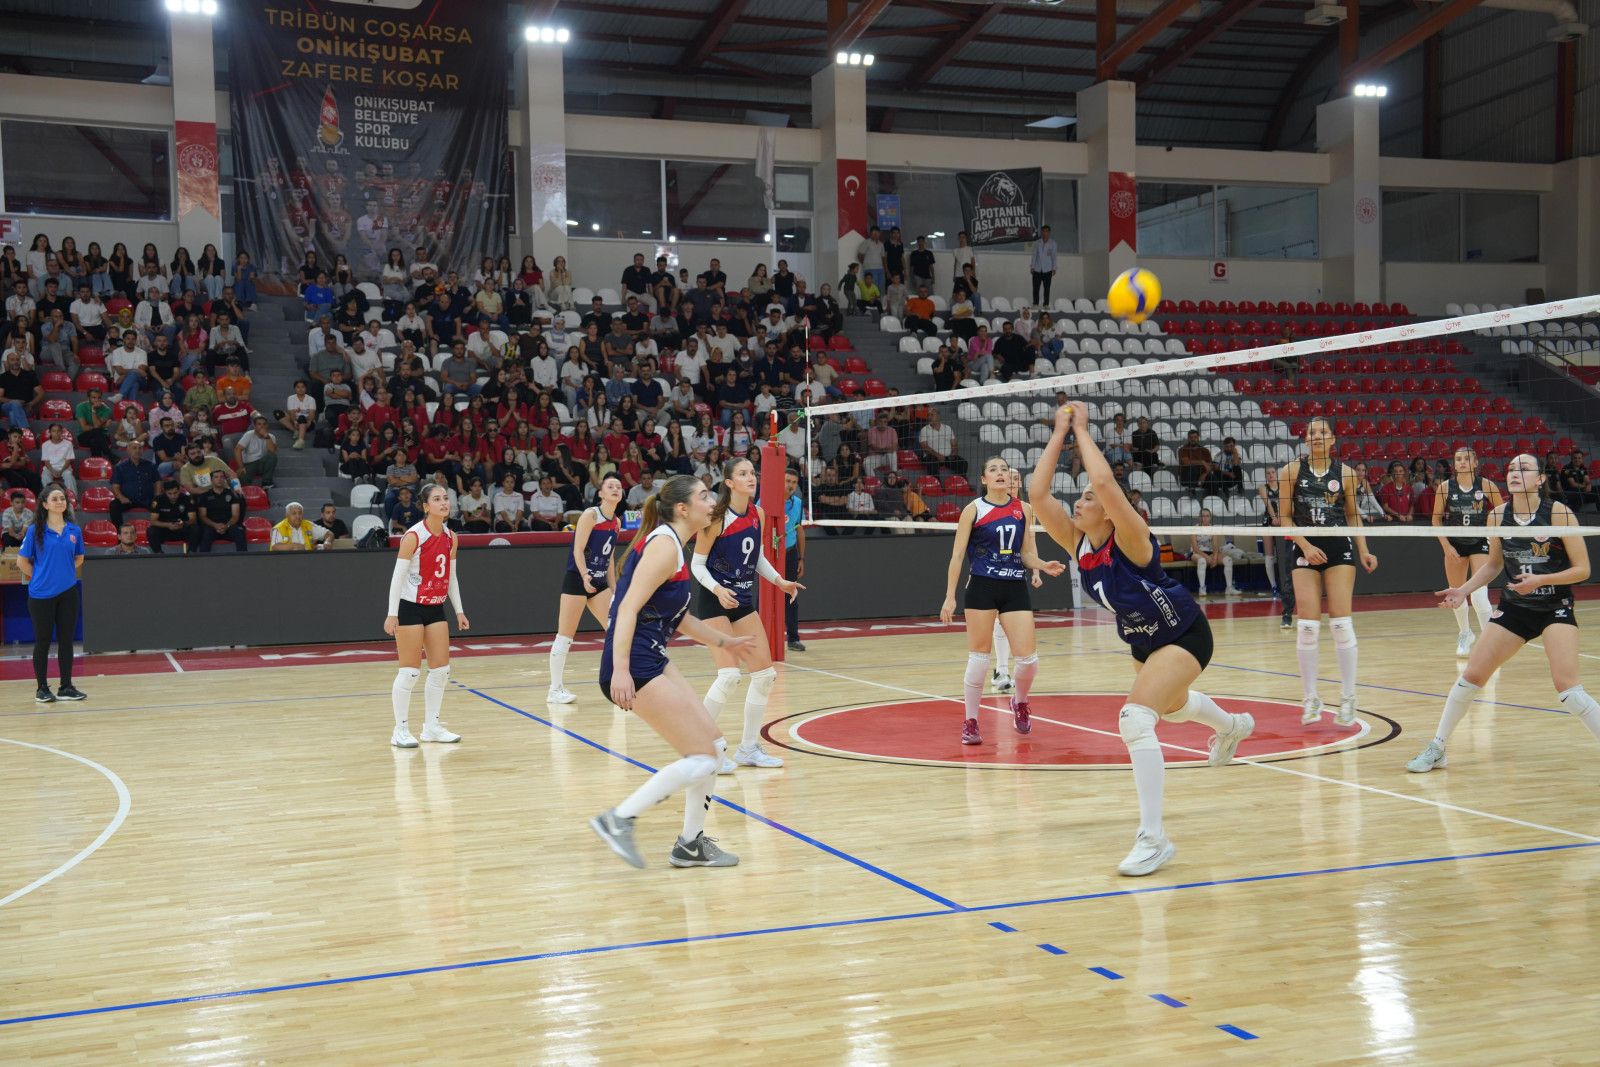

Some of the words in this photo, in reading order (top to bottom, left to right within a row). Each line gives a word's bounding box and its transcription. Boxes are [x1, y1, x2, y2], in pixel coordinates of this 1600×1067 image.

[264, 7, 355, 33] TRİBÜN
[364, 19, 473, 44] COŞARSA
[296, 36, 444, 65] ONİKİŞUBAT
[281, 59, 373, 84] ZAFERE
[382, 70, 459, 92] KOŞAR
[355, 123, 391, 135] SPOR
[979, 205, 1025, 220] POTANIN
[0, 220, 12, 239] F
[974, 216, 1031, 233] ASLANLARI
[1214, 262, 1226, 278] G
[626, 512, 635, 520] 19
[1309, 507, 1326, 524] 14
[1462, 514, 1471, 526] 6
[602, 535, 613, 555] 6
[996, 524, 1017, 550] 17
[741, 536, 755, 565] 9
[434, 553, 446, 578] 3
[986, 565, 1025, 578] T-BIKE
[1519, 564, 1533, 574] 11
[1121, 621, 1159, 637] BIKE
